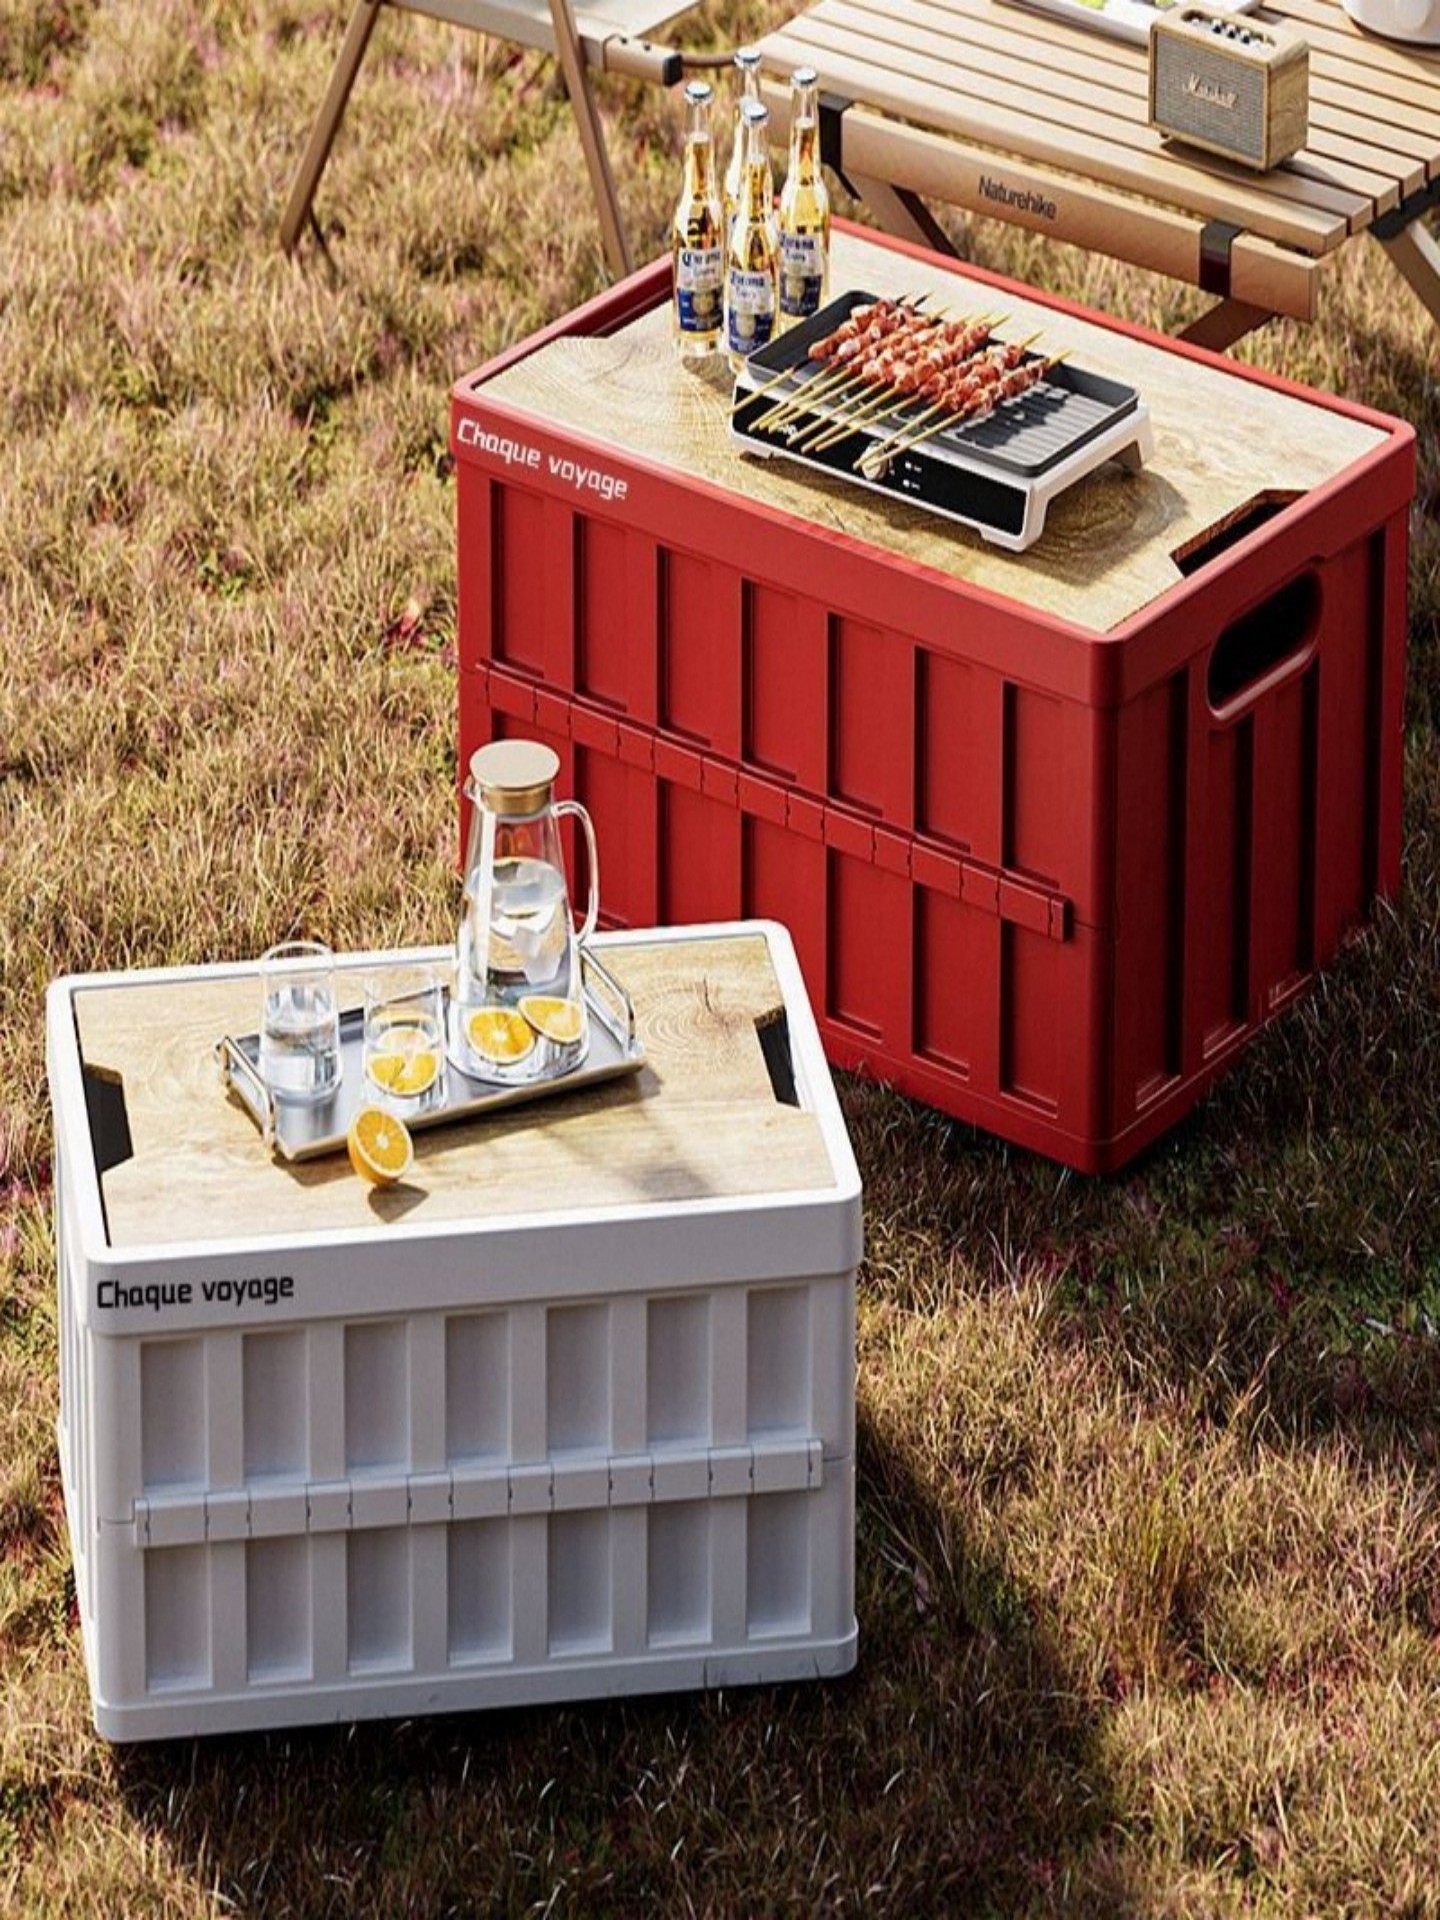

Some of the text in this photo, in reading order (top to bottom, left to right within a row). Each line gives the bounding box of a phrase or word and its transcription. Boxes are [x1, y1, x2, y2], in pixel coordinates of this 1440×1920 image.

[979, 174, 1057, 220] Naturehike
[457, 417, 628, 500] Chaque voyage
[97, 1276, 294, 1312] Chaque voyage
